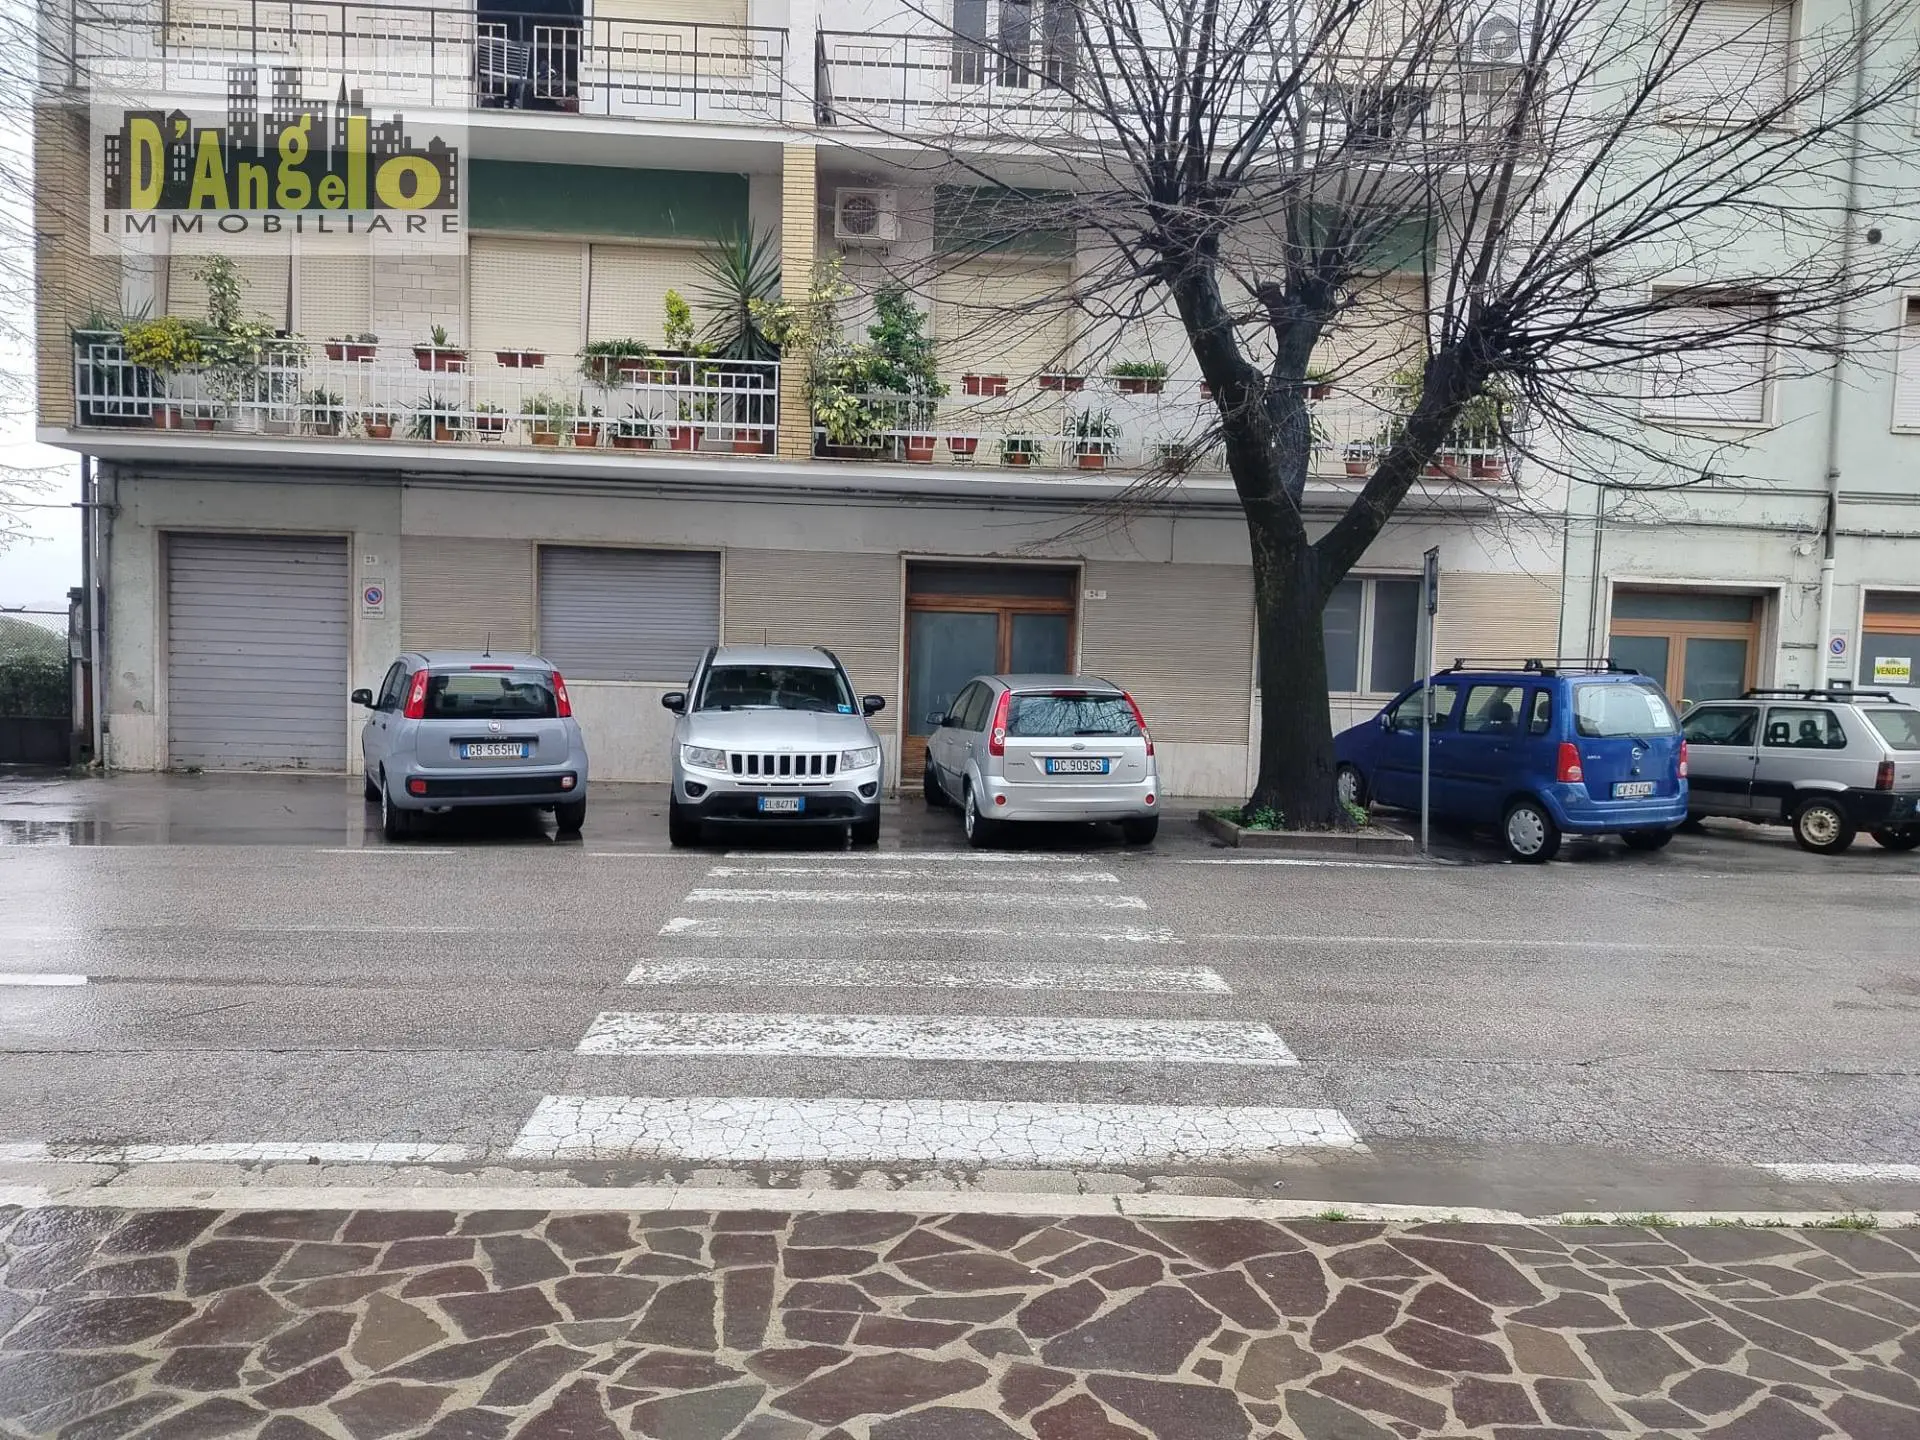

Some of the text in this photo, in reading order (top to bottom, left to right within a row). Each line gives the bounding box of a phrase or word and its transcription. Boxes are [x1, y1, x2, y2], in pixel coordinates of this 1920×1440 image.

[1875, 666, 1909, 676] VENDESI
[487, 744, 521, 756] 565HV
[1053, 760, 1102, 771] DC 909GS
